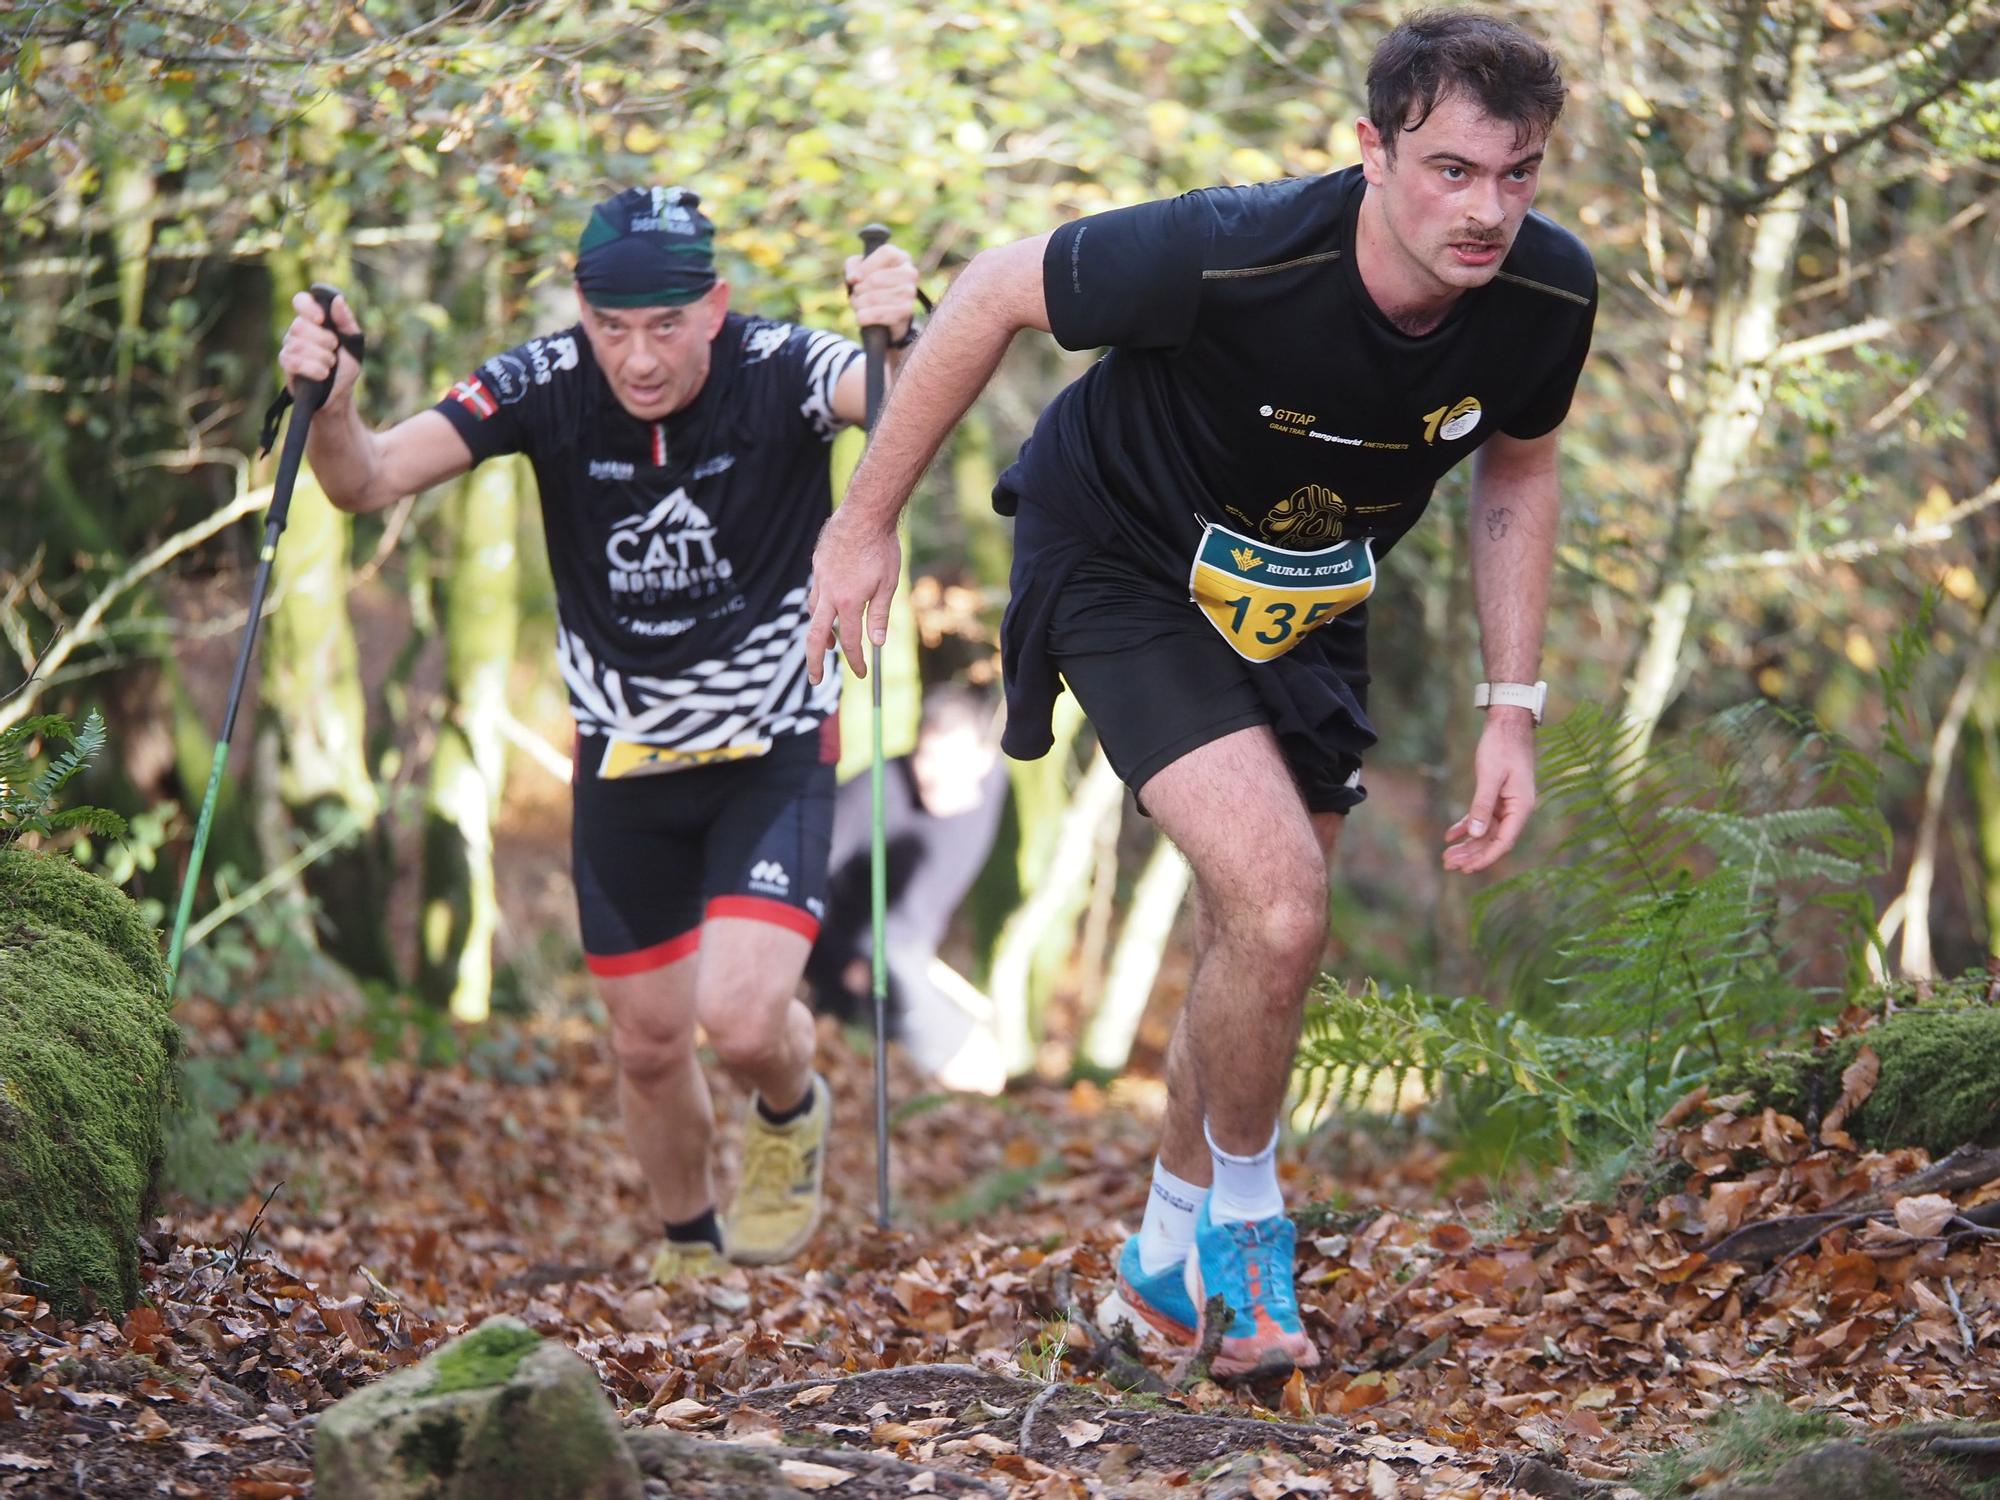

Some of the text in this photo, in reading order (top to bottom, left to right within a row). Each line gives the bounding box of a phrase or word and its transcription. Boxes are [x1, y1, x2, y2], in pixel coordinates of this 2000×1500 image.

[1274, 409, 1316, 425] GTTAP
[1269, 422, 1288, 433] GRAN
[1288, 426, 1306, 437] TRAIL
[1308, 430, 1363, 447] trangoworld
[606, 527, 718, 573] CATT
[1265, 559, 1354, 577] RURAL KUTXA
